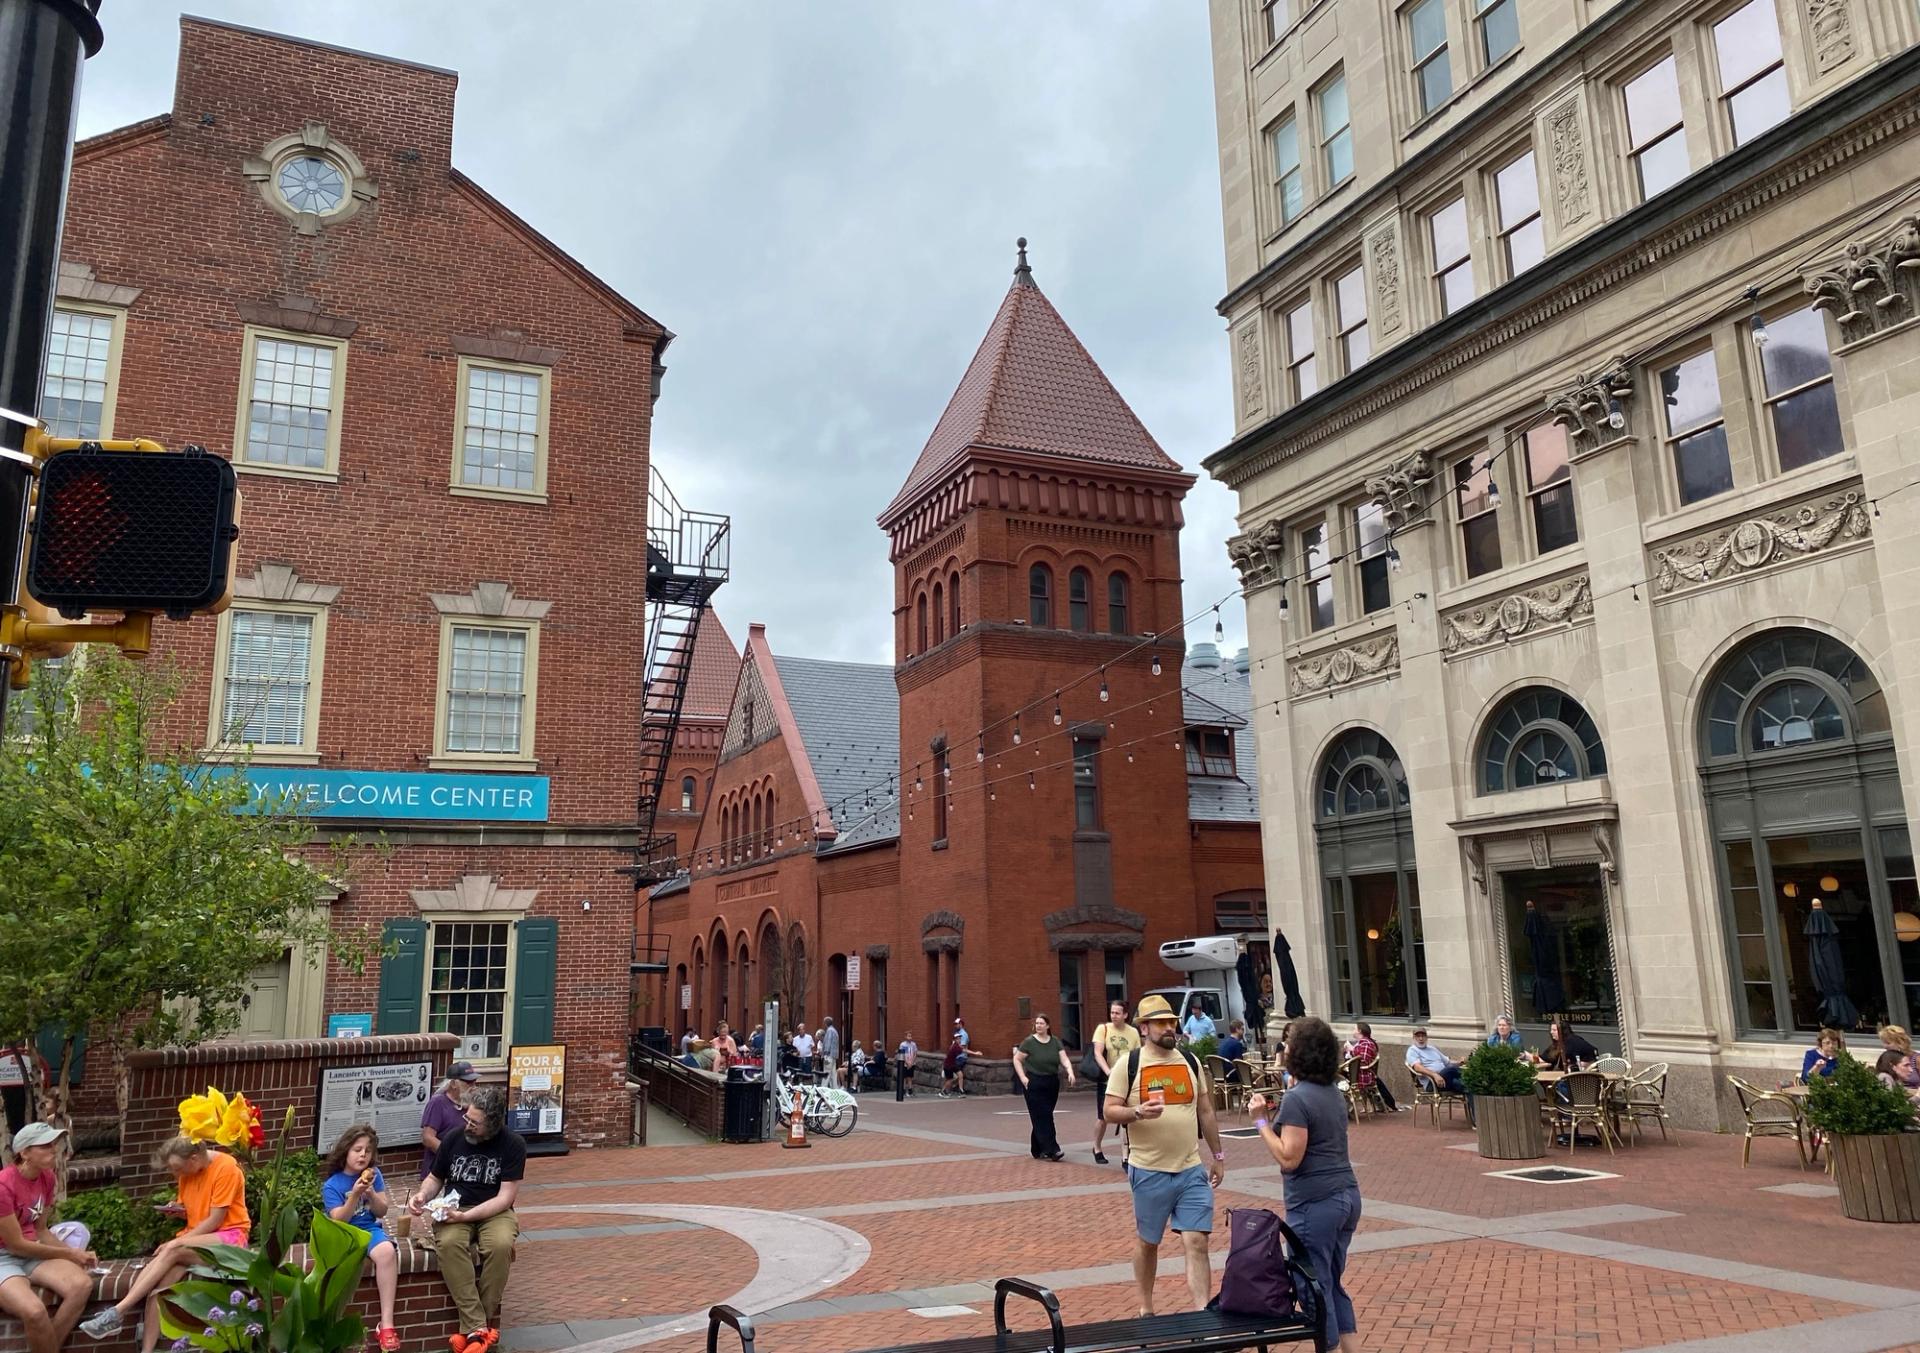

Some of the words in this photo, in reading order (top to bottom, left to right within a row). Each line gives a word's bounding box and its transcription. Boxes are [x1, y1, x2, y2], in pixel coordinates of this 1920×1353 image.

[279, 783, 420, 805] WELCOME
[430, 787, 533, 808] CENTER
[1571, 1014, 1591, 1022] SHOP
[514, 1056, 550, 1067] TOUR
[552, 1055, 562, 1066] &
[511, 1067, 563, 1076] ACTIVITIES
